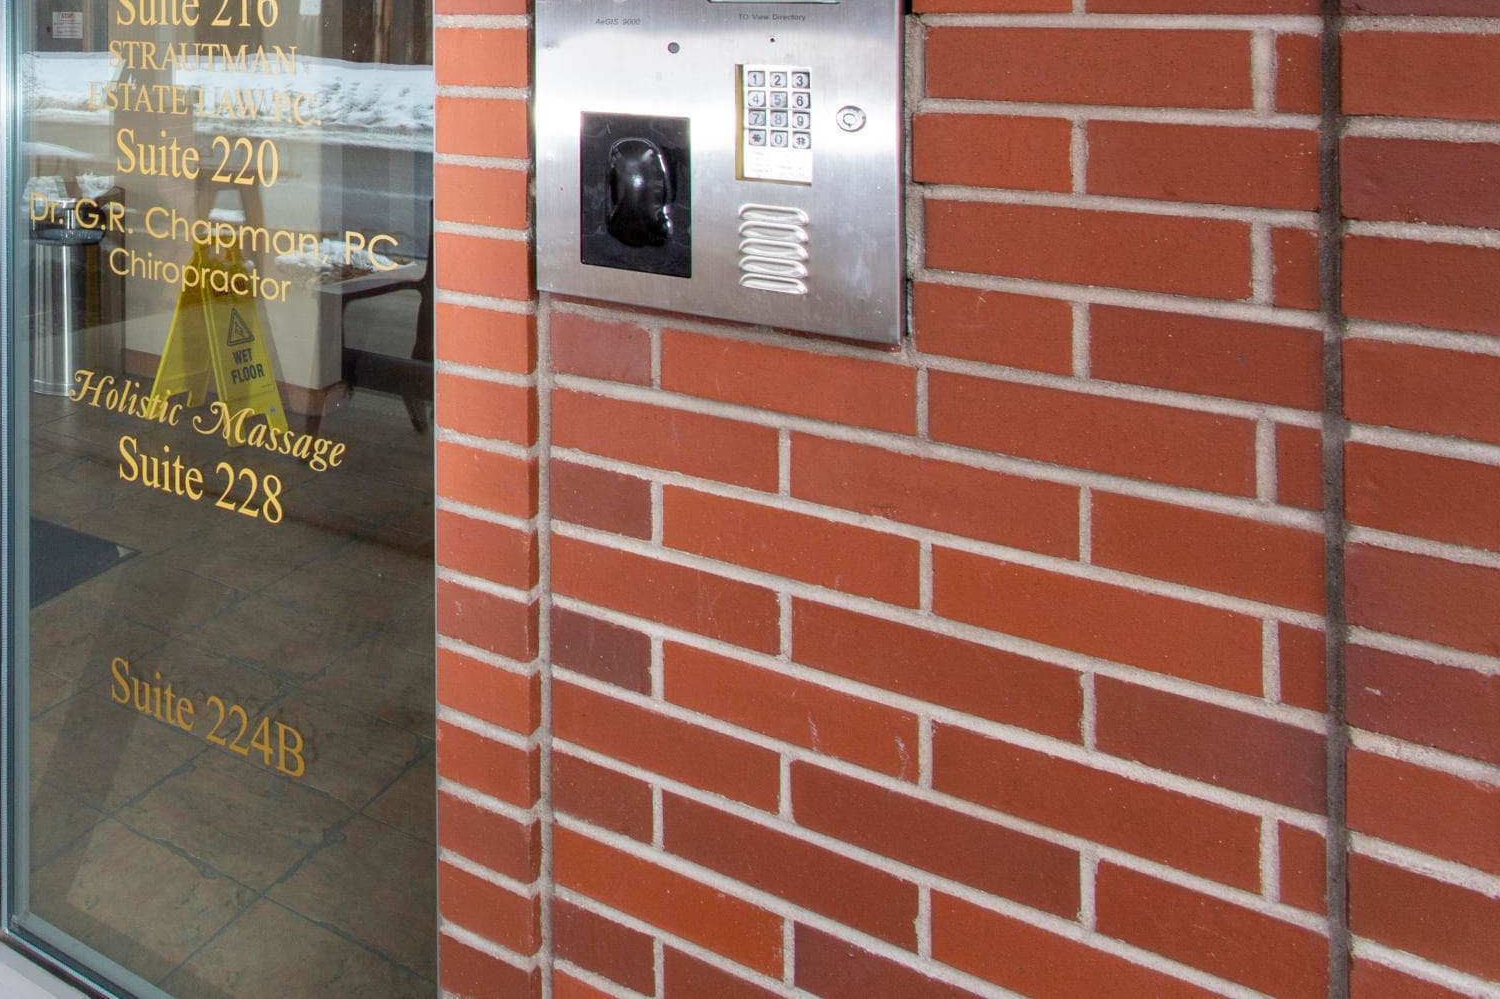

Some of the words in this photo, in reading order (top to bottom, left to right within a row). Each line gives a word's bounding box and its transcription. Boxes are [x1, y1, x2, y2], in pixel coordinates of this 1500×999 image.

[772, 14, 805, 22] Directory
[109, 39, 298, 75] STRAUTMAN
[88, 82, 188, 117] ESTATE
[198, 85, 263, 122] LAW
[116, 128, 200, 179] Suite
[211, 135, 280, 188] 220
[30, 192, 64, 224] Dr.
[75, 199, 133, 235] G.R.
[145, 206, 329, 263] Chapman,
[344, 230, 399, 271] PC
[109, 247, 291, 302] Chiropractor
[231, 364, 264, 384] FLOOR
[232, 348, 252, 365] WET
[69, 369, 183, 426] Holistic
[193, 401, 347, 472] Massage
[118, 436, 204, 500] Suite
[216, 463, 283, 524] 228
[111, 657, 195, 731] Suite
[207, 696, 305, 778] 224B
